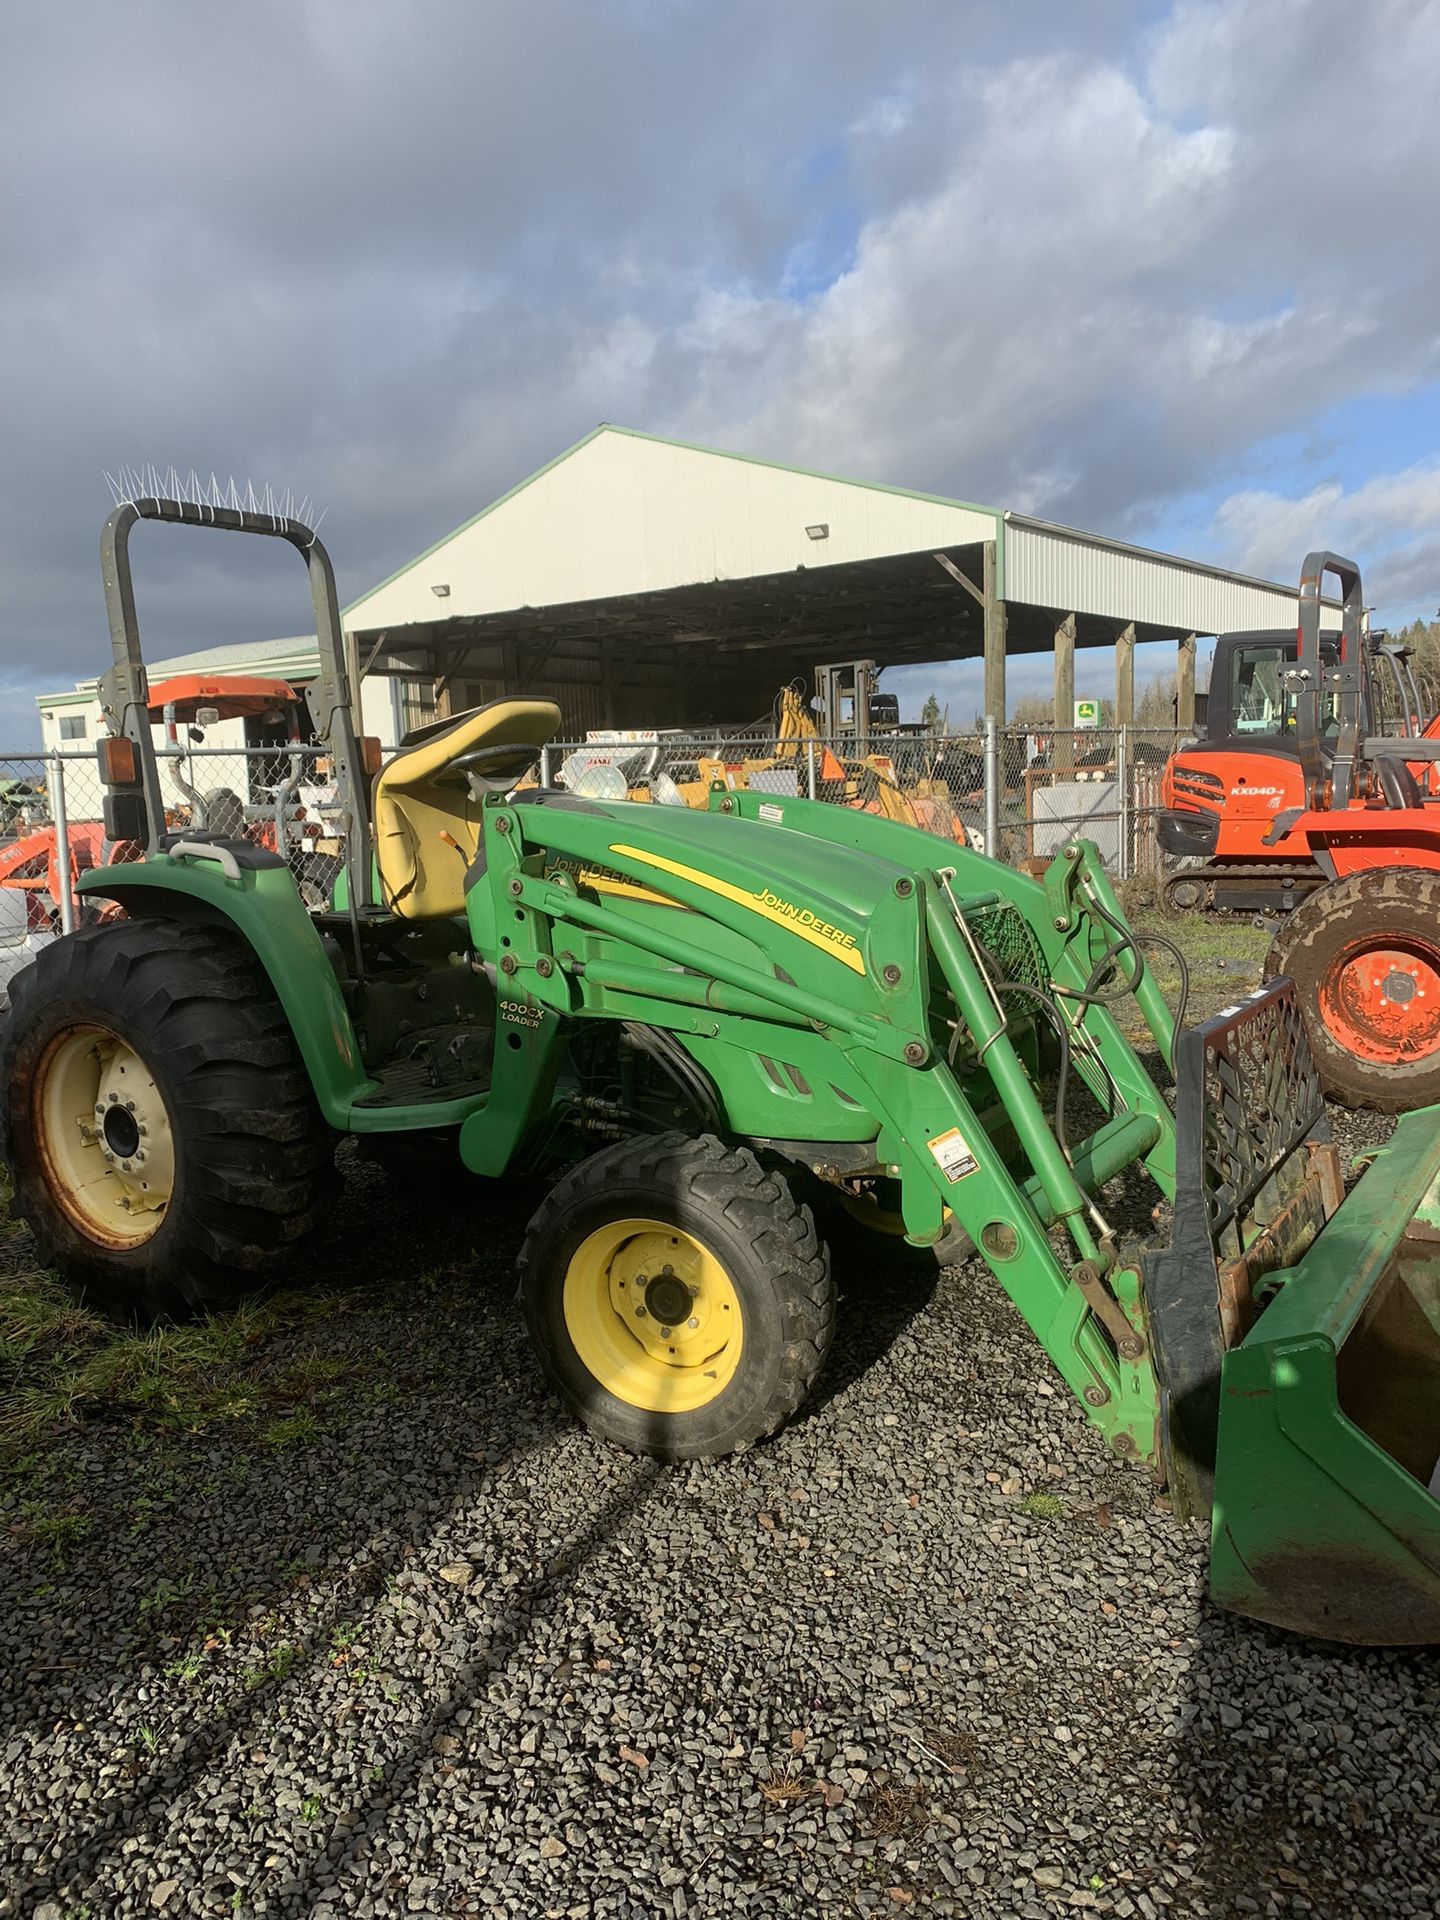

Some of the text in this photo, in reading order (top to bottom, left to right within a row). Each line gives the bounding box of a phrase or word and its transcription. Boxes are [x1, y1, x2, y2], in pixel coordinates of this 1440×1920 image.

[549, 856, 589, 878] JOHN
[753, 888, 857, 949] JOHN DEERE
[500, 1001, 545, 1020] 400CX
[502, 1013, 539, 1029] LOADER
